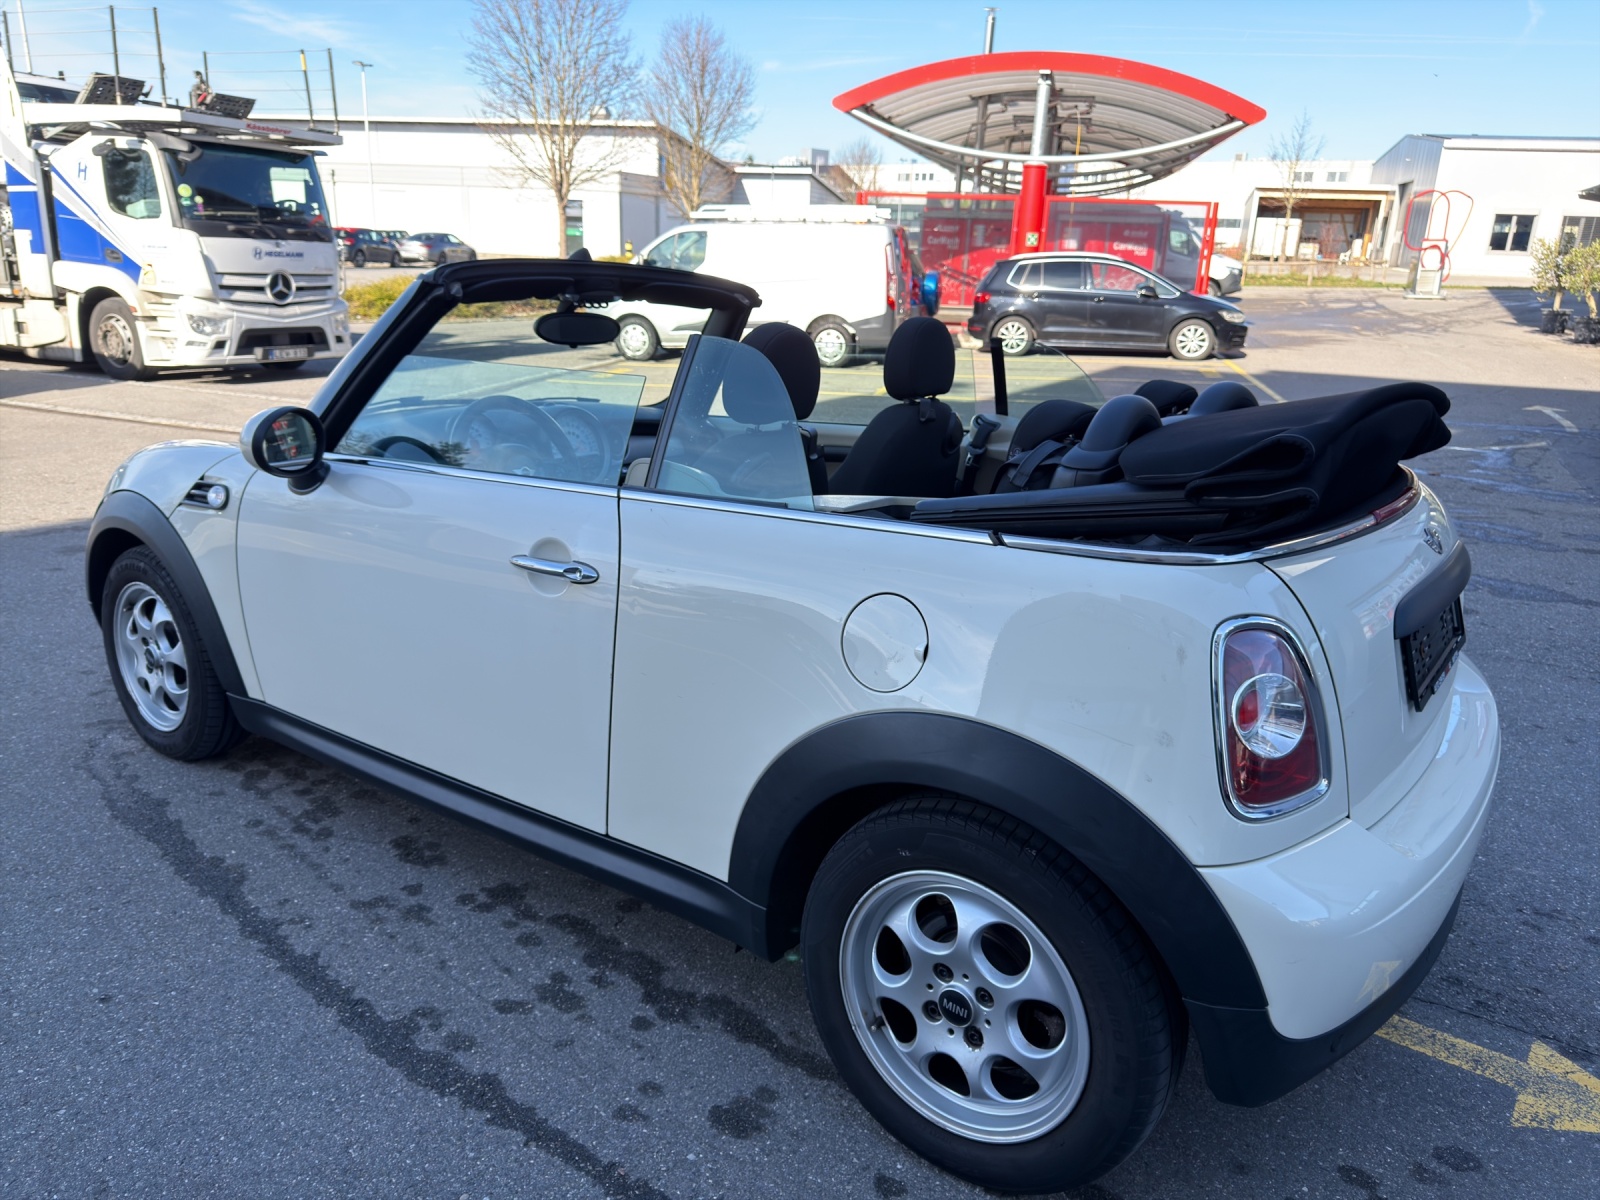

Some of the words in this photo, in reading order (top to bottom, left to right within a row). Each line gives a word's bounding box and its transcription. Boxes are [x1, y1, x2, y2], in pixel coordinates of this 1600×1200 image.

[927, 235, 960, 246] CarWash
[1113, 241, 1148, 251] CarWash
[943, 998, 968, 1018] MINI
